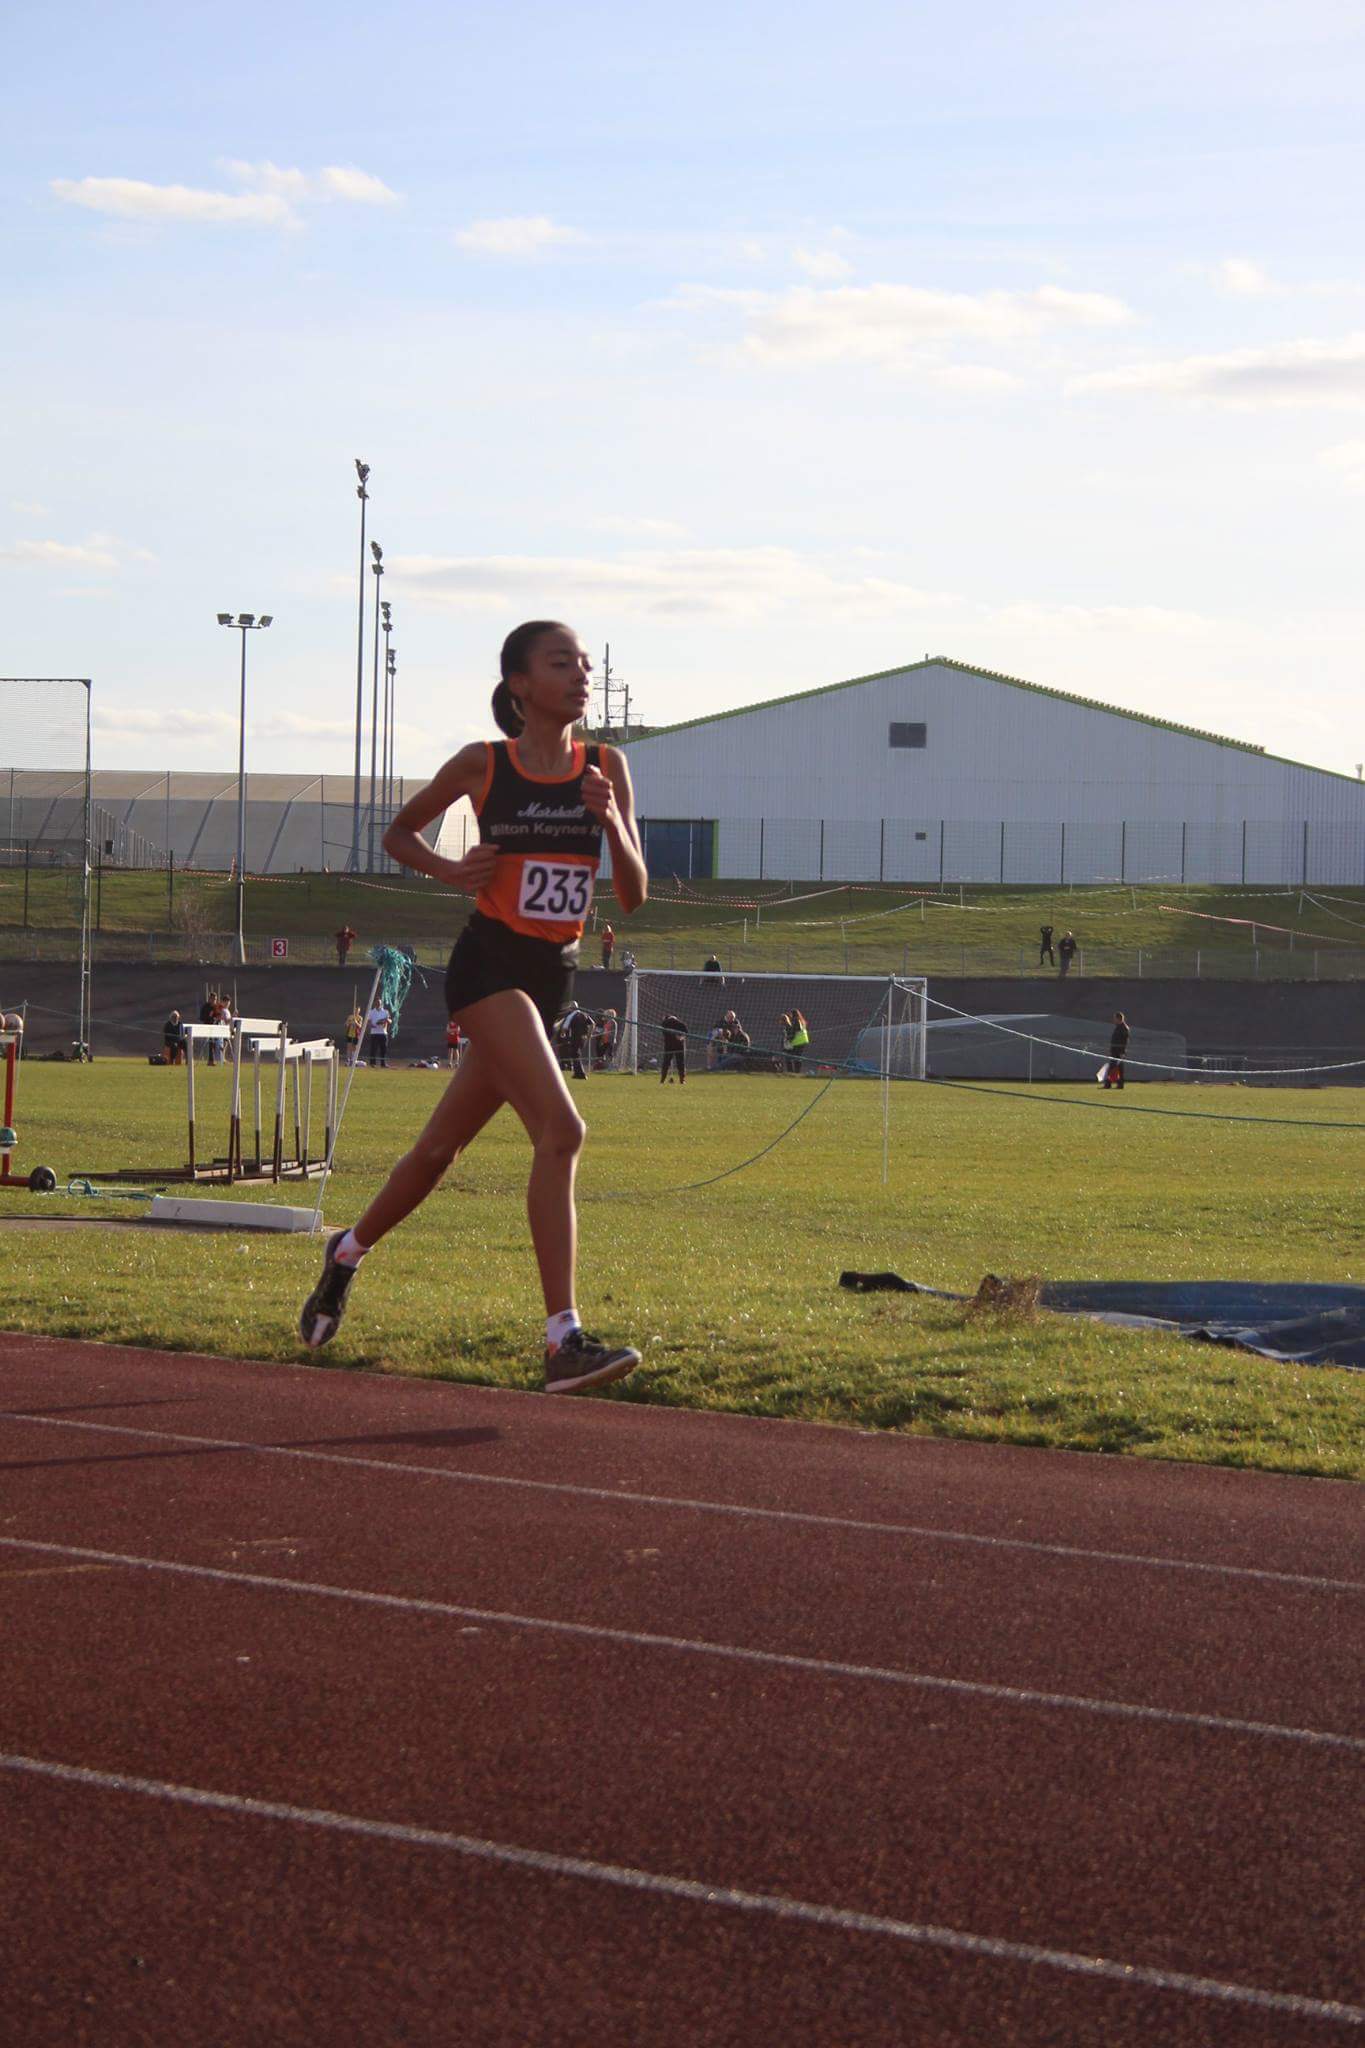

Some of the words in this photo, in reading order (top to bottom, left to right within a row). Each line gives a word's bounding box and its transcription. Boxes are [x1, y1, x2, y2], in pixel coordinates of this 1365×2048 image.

[517, 802, 586, 818] Marshall
[534, 822, 587, 837] Keynes
[524, 866, 590, 914] 233
[275, 941, 285, 956] 3
